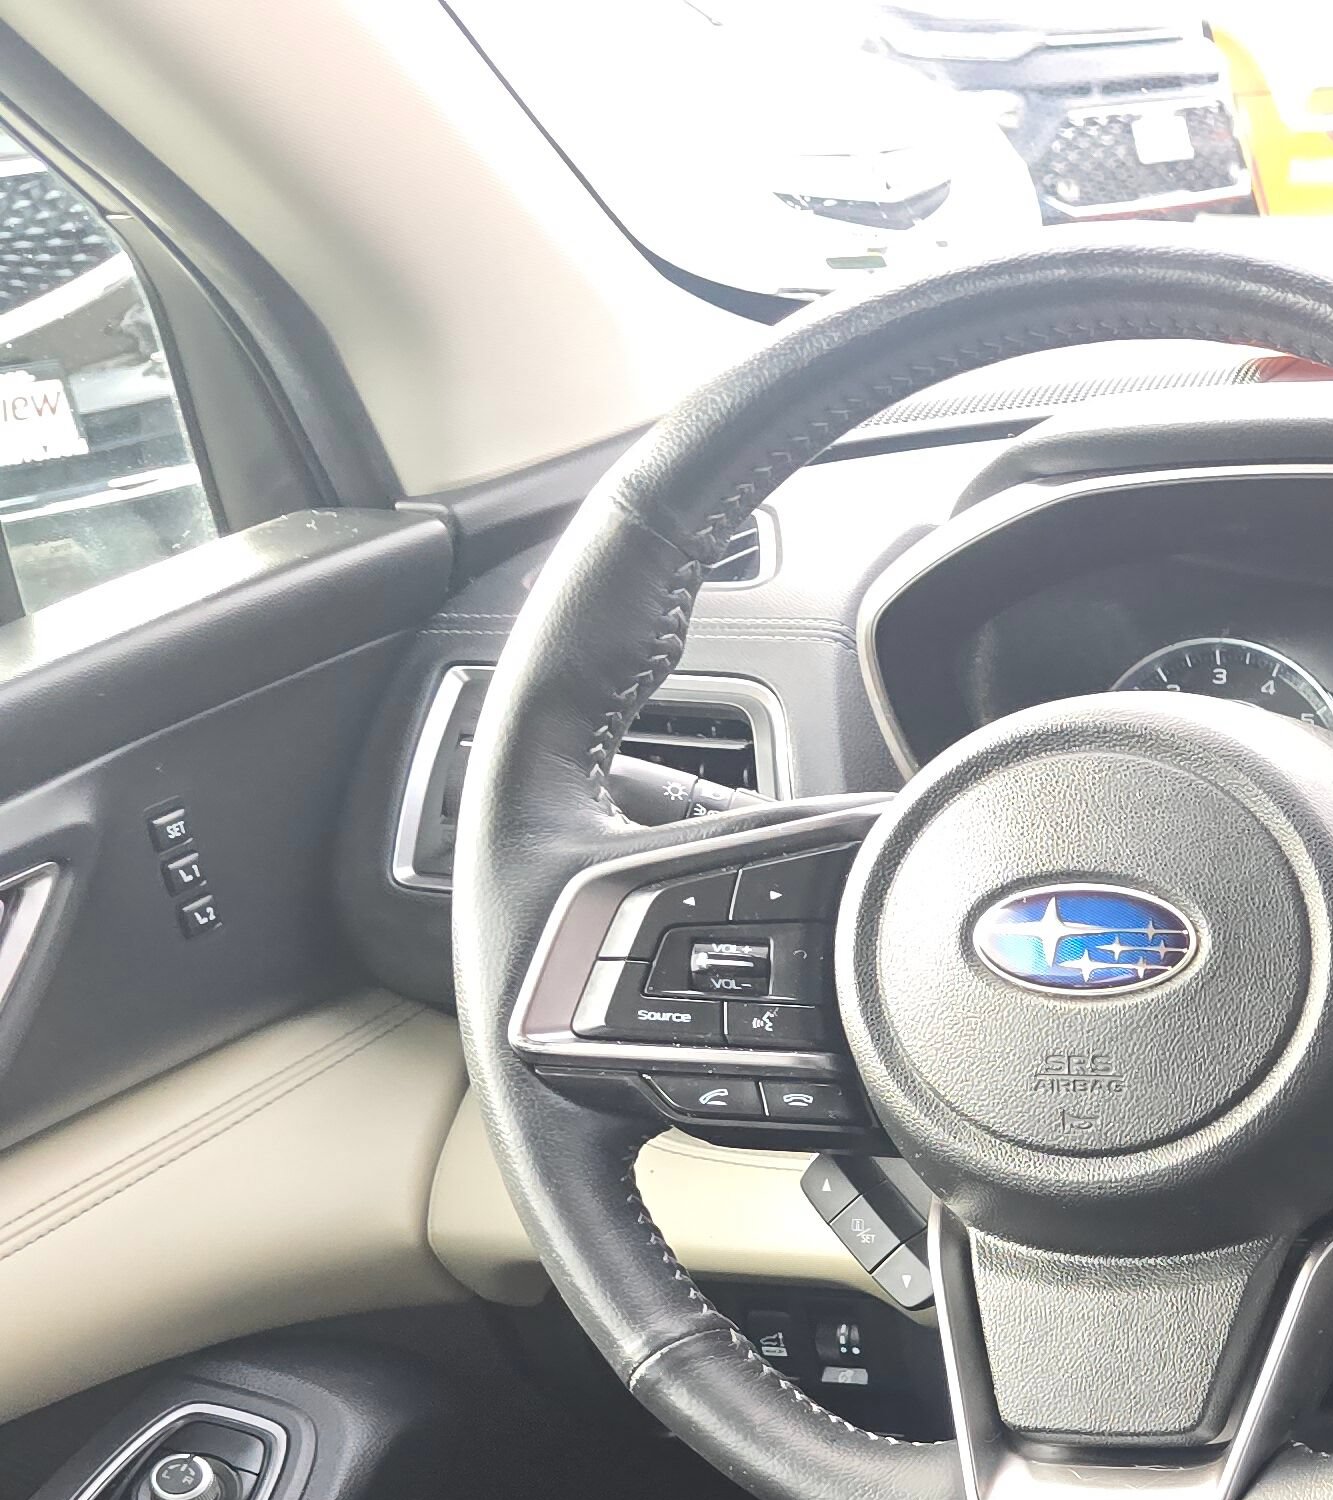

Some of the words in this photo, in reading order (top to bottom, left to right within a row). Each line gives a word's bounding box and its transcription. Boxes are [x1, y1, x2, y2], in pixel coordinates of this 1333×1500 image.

[1212, 668, 1227, 685] 3
[1261, 680, 1276, 695] 4
[166, 820, 186, 839] SET
[637, 1009, 692, 1023] Source
[1044, 1054, 1113, 1074] SRS
[1033, 1079, 1123, 1093] AIRBAG
